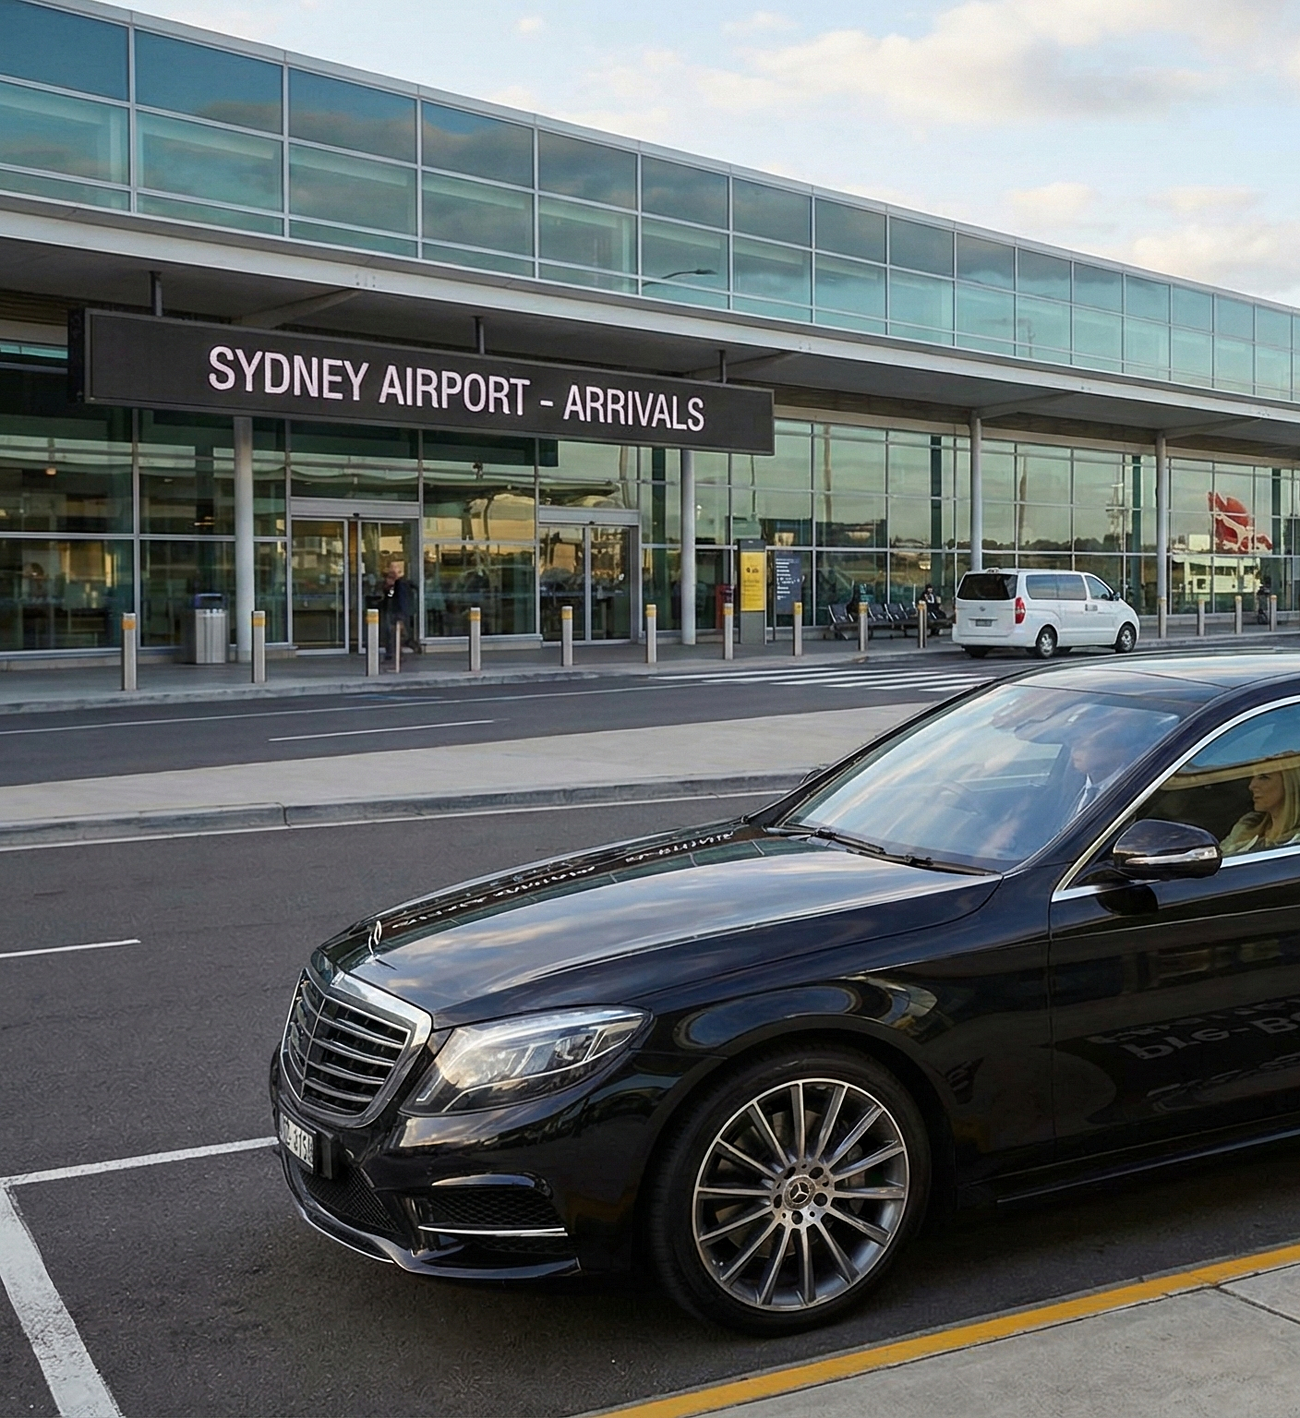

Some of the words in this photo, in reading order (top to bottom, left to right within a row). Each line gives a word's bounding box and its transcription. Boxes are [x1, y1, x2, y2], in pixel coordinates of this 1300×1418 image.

[208, 345, 370, 402] SYDNEY
[378, 365, 531, 416] AIRPORT
[540, 399, 554, 407] -
[563, 384, 706, 432] ARRIVALS
